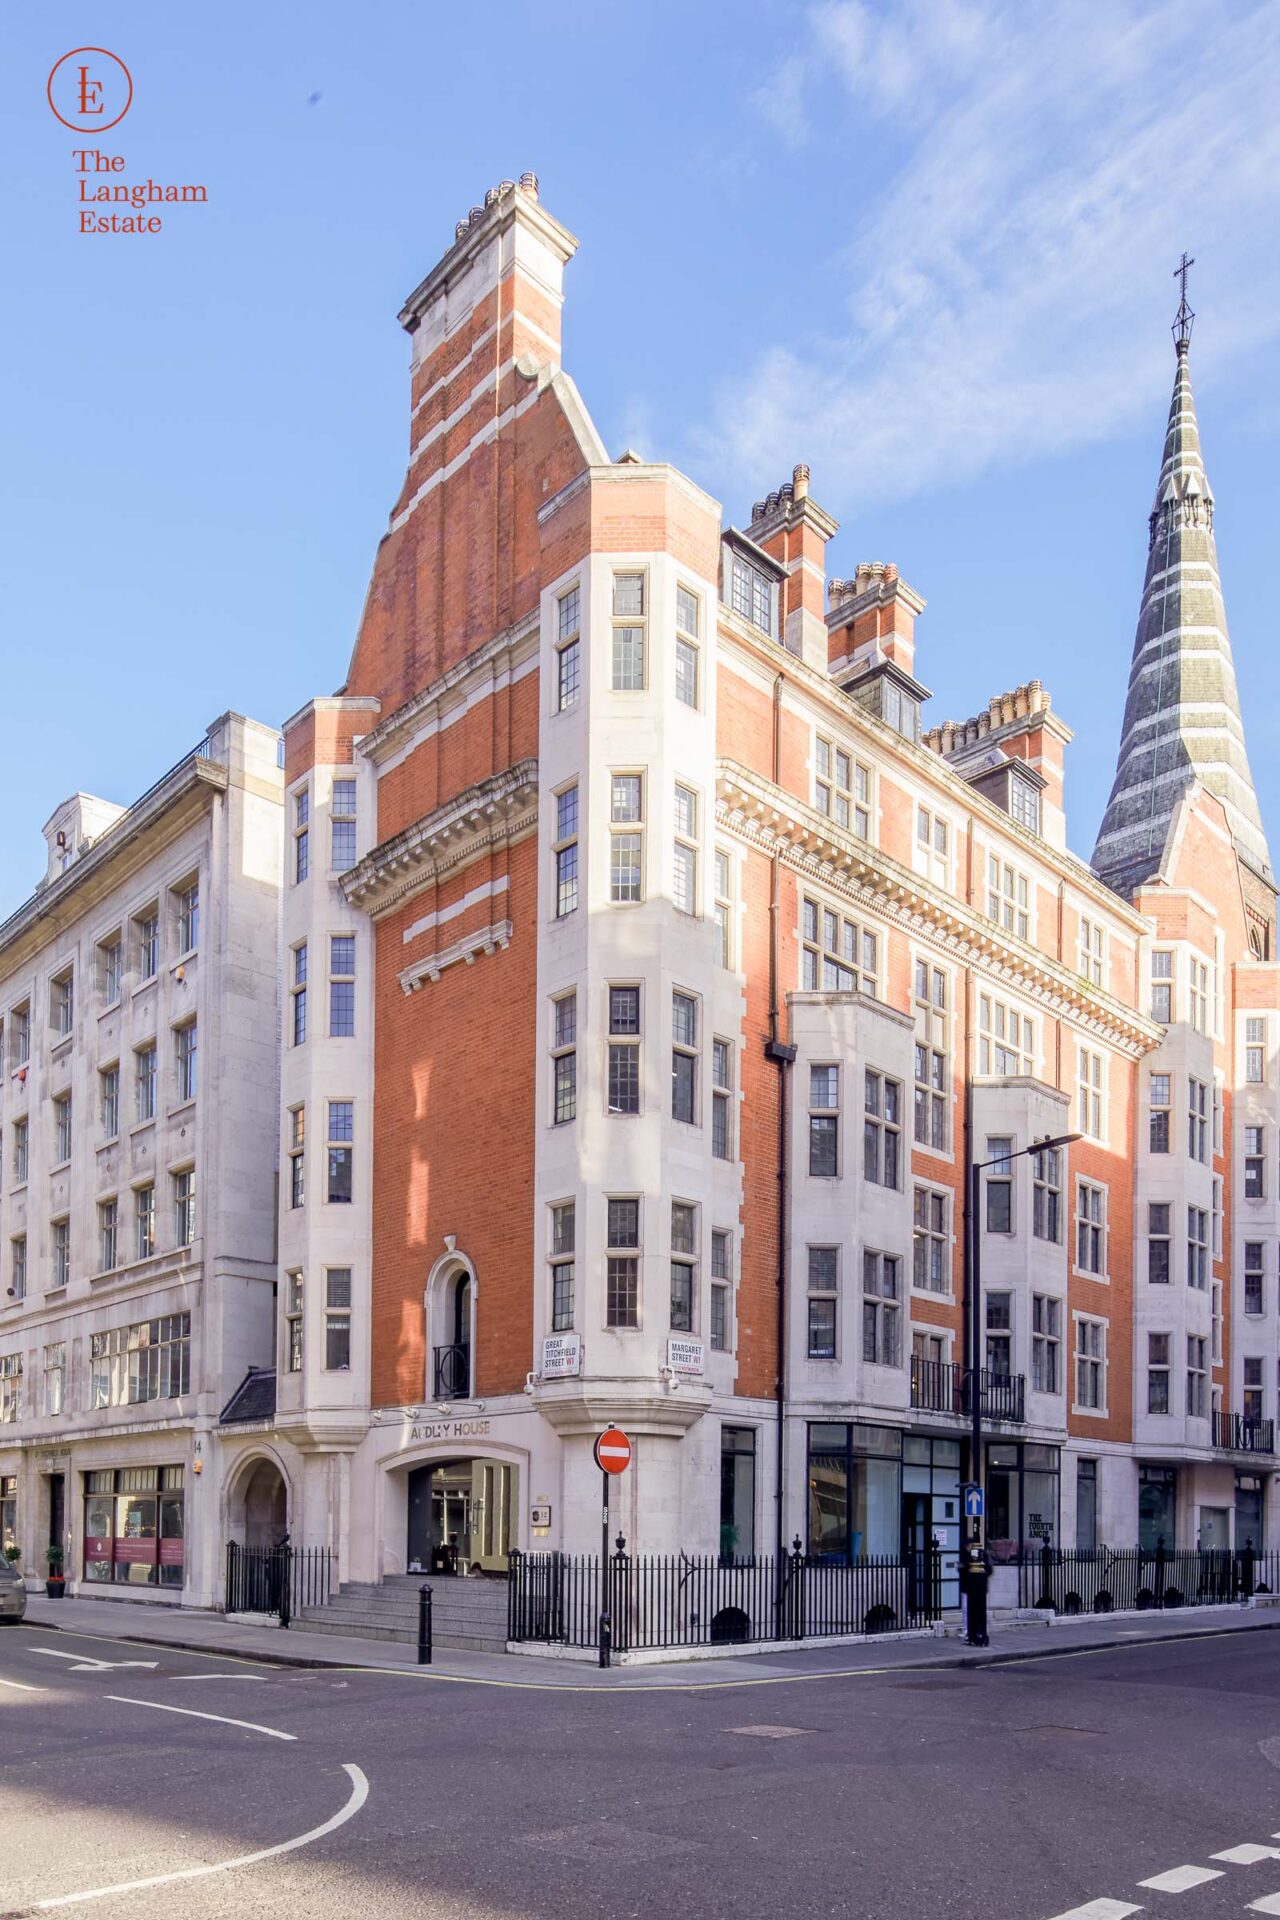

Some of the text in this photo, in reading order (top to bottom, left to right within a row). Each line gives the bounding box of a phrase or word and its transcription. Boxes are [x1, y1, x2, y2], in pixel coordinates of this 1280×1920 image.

[545, 1340, 563, 1349] GREAT
[671, 1343, 702, 1355] MARGARET
[545, 1347, 576, 1358] TITCHFIELD
[671, 1352, 701, 1364] STREET W1
[545, 1357, 575, 1368] STREET W1
[454, 1421, 490, 1436] HOUSE
[1029, 1513, 1042, 1522] THE
[1029, 1522, 1054, 1531] FOURTH
